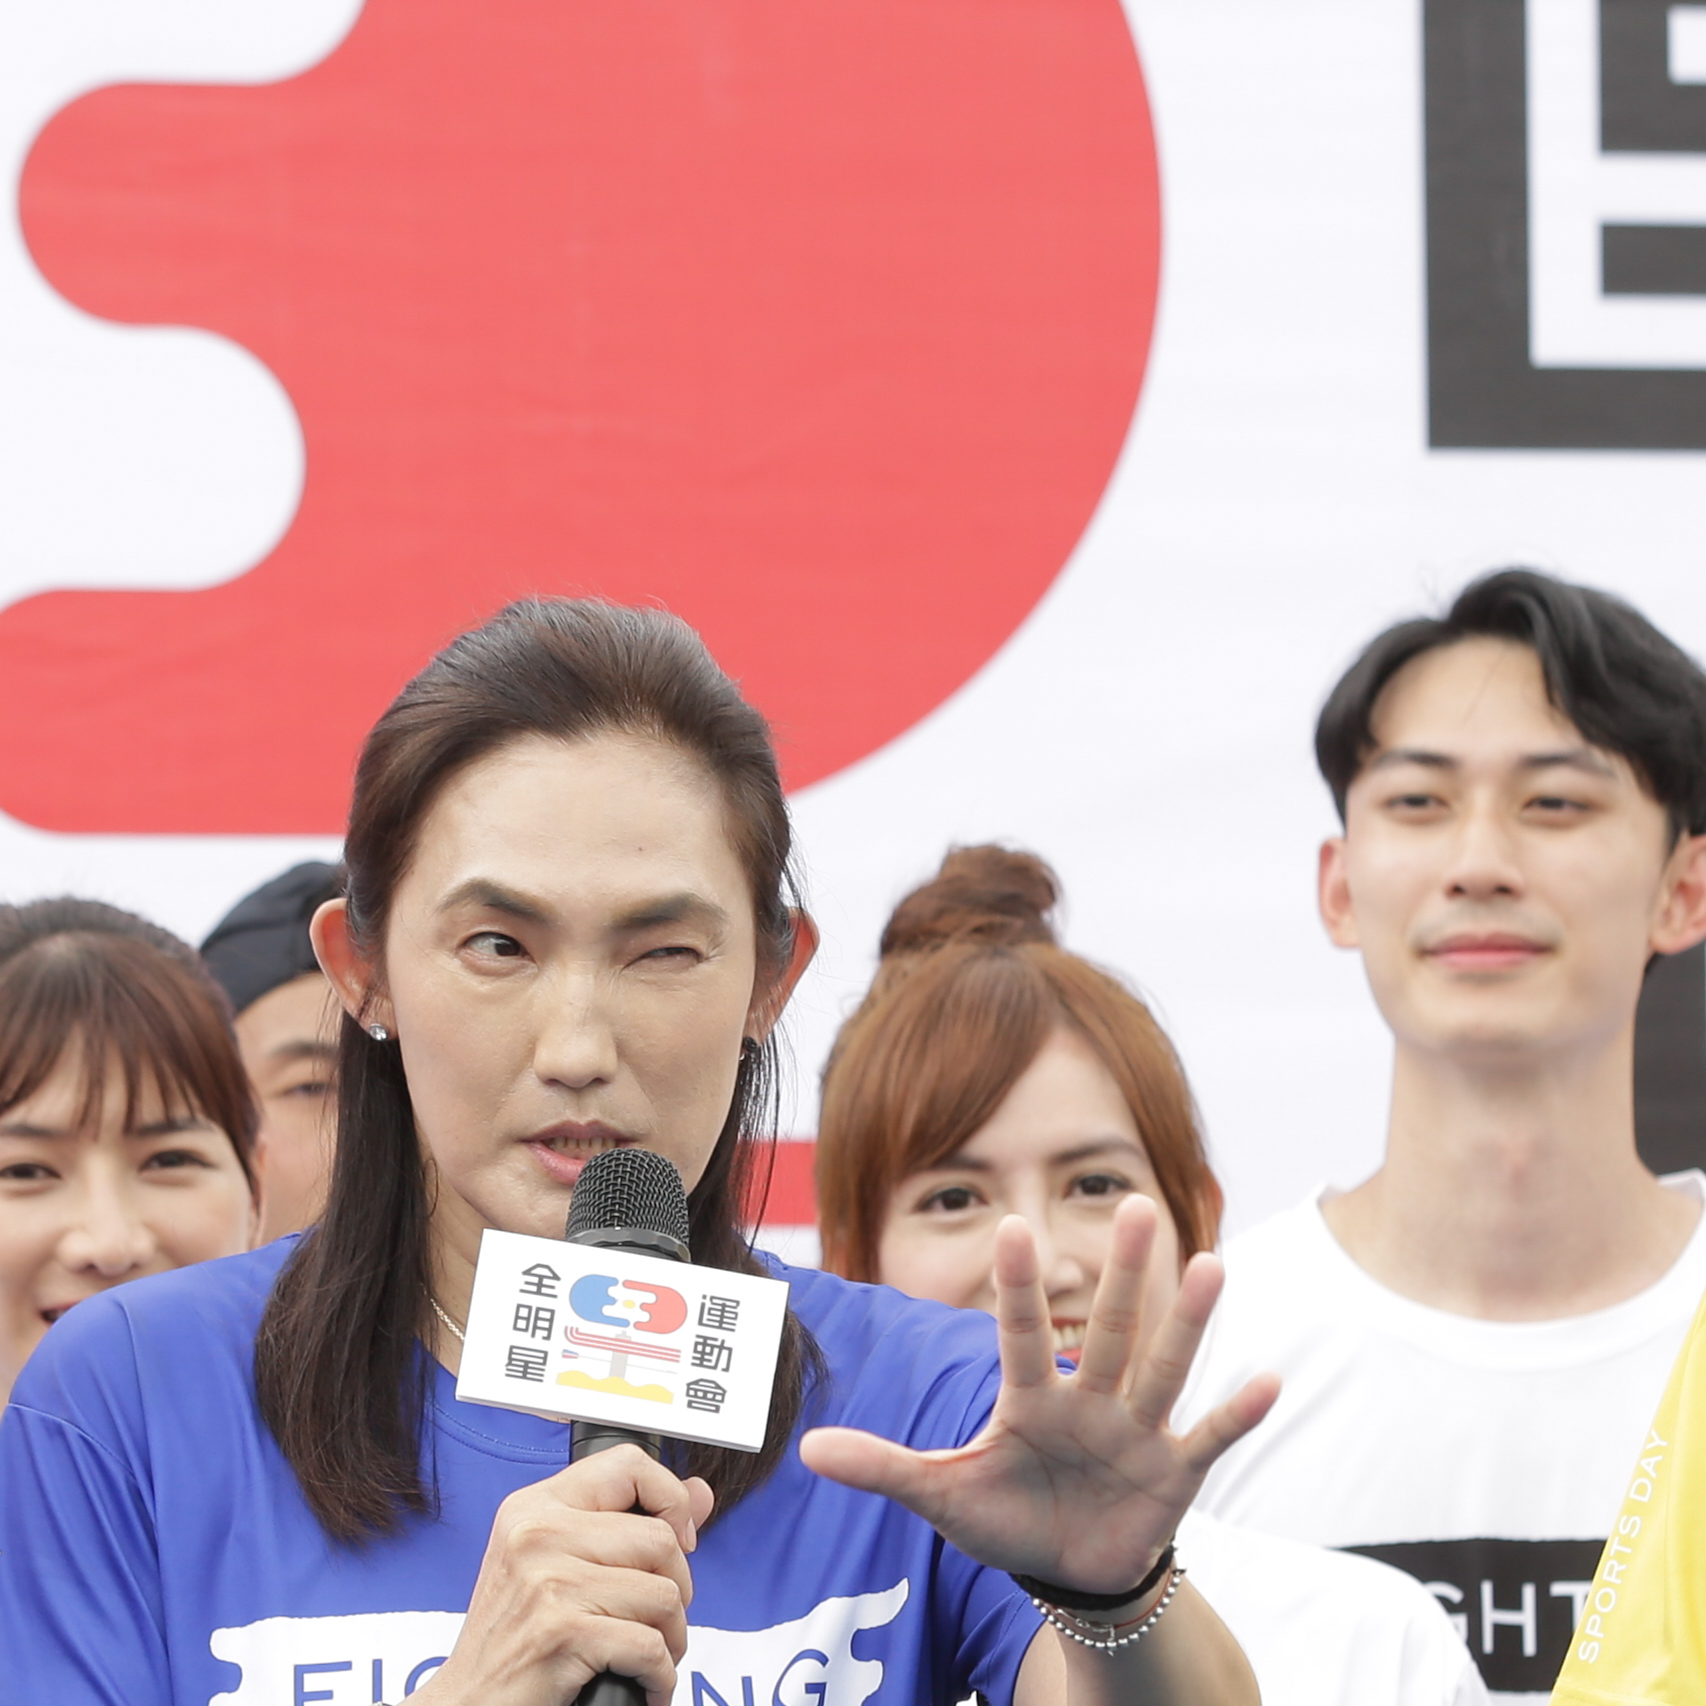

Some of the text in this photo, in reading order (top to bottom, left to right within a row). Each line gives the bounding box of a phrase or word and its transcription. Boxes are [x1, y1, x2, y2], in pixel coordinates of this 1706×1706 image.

[505, 1263, 561, 1382] 全明星
[685, 1294, 740, 1414] 運動會
[1578, 1429, 1669, 1664] SPORTS DAY
